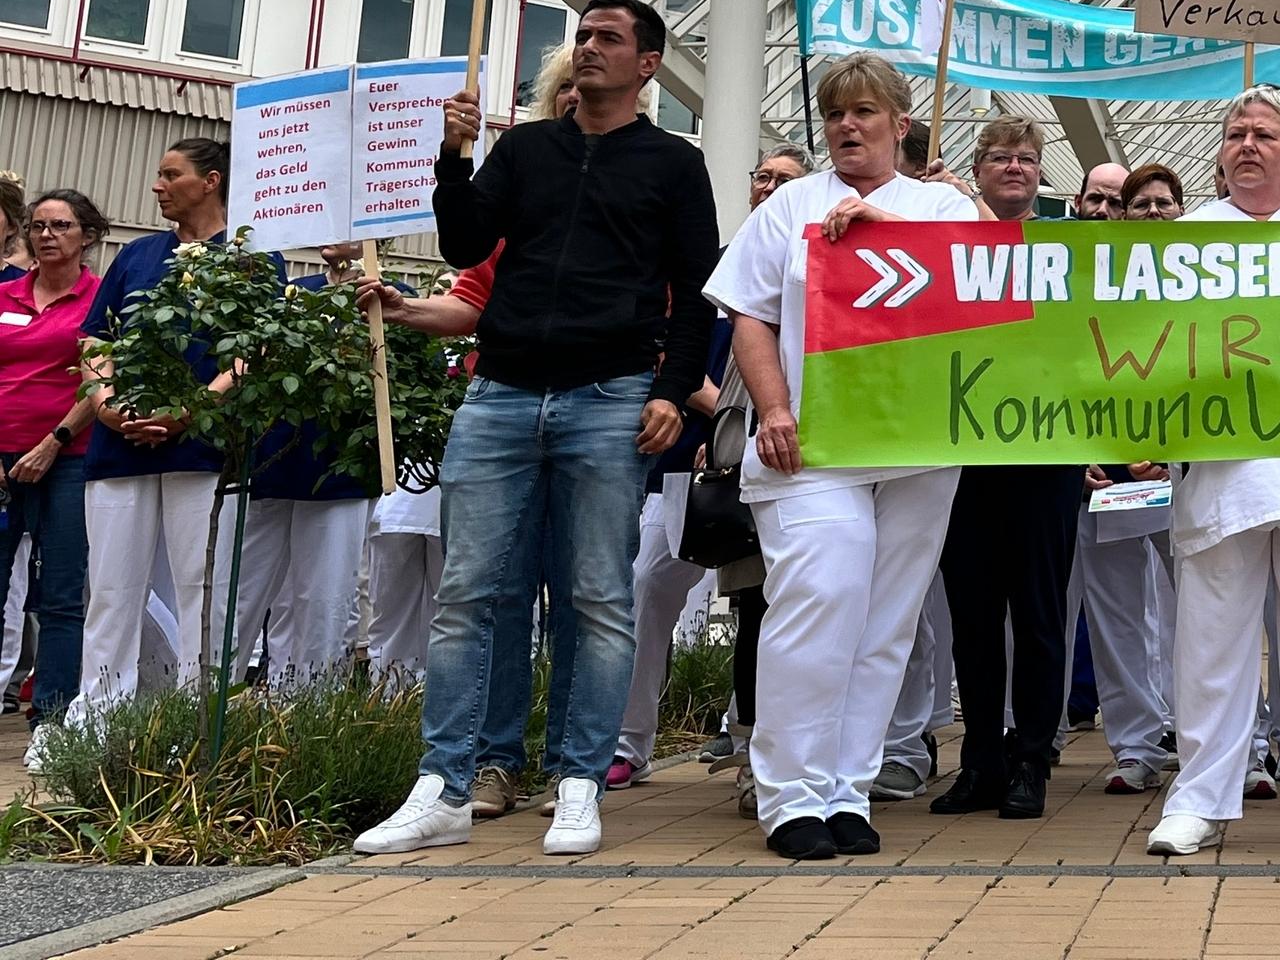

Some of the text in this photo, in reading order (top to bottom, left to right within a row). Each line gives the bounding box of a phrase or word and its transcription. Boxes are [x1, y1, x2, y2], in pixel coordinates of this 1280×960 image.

[369, 82, 399, 93] Euer
[259, 98, 331, 118] Wir müssen
[259, 122, 310, 139] uns jetzt
[368, 117, 424, 132] ist unser
[257, 143, 307, 159] wehren,
[367, 137, 417, 152] Gewinn
[256, 161, 308, 180] das Geld
[254, 179, 326, 202] geht zu den
[253, 201, 323, 221] Aktionären
[365, 197, 420, 214] erhalten
[950, 242, 1072, 303] WIR
[1088, 315, 1271, 381] WIR
